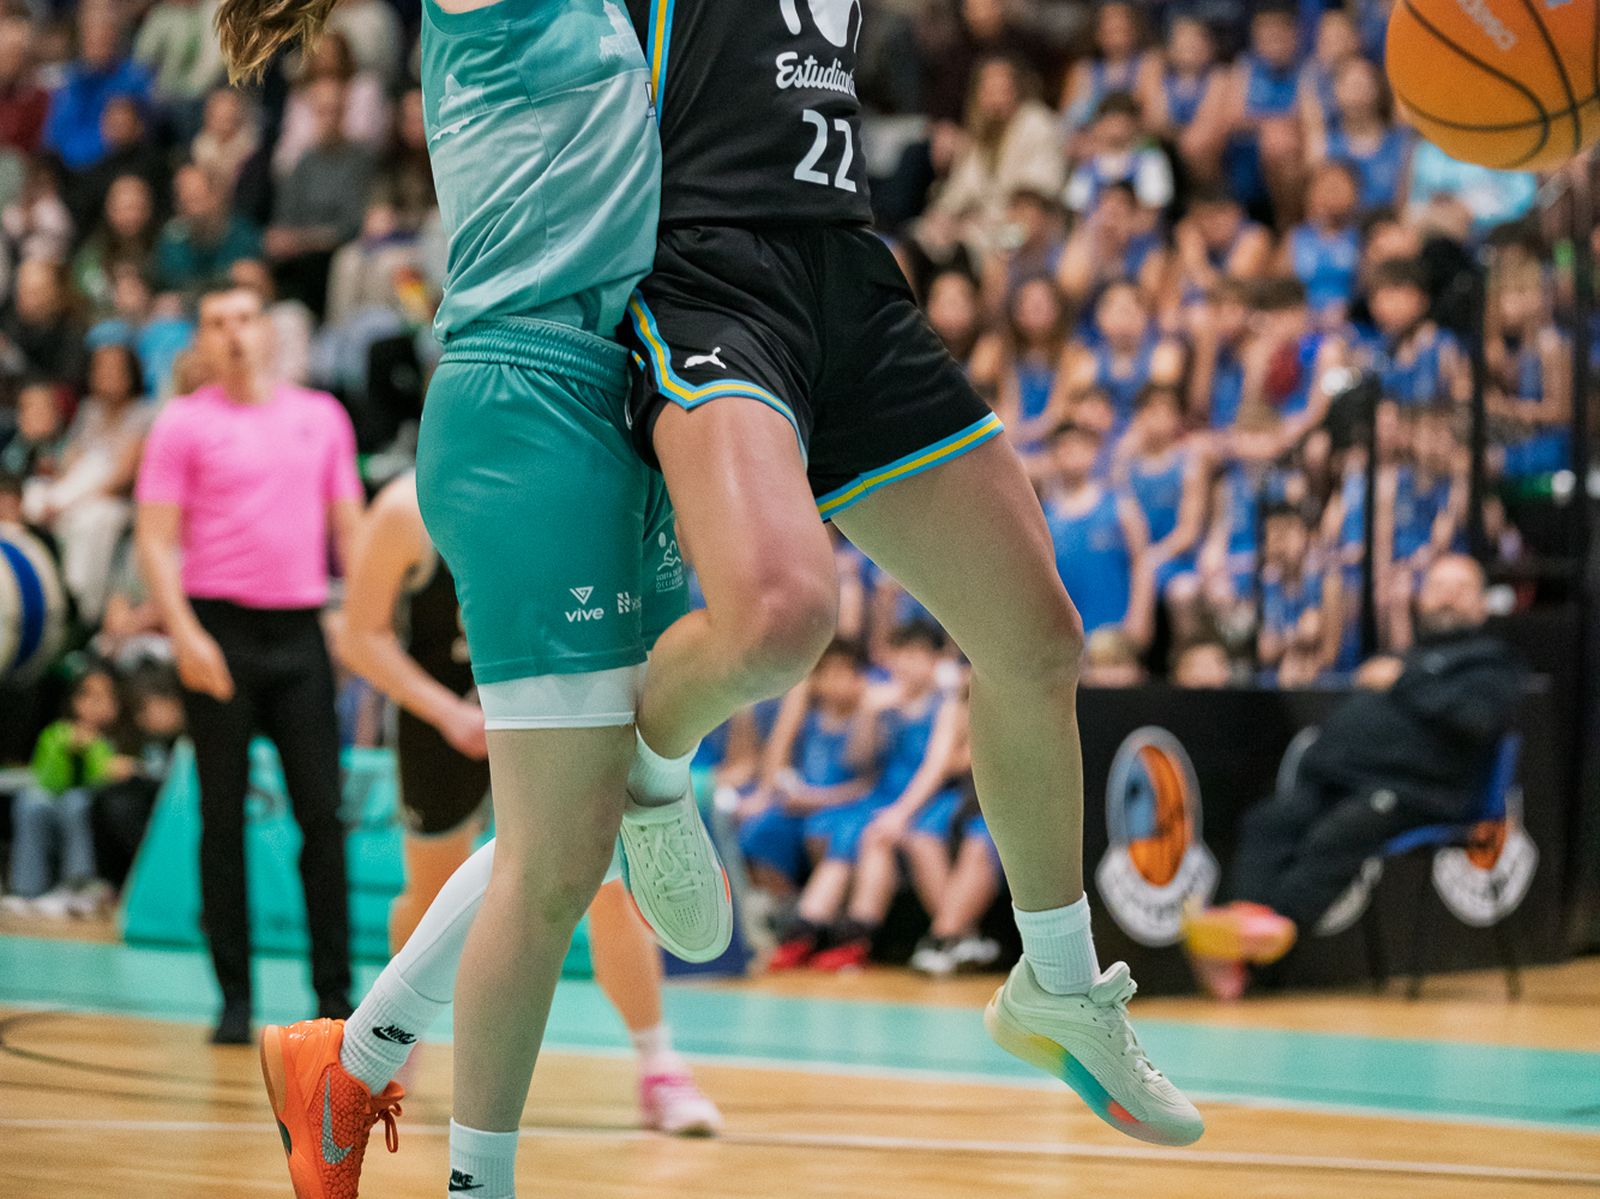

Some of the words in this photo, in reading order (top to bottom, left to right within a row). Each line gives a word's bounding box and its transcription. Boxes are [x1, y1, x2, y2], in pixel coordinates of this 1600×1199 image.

[793, 109, 857, 193] 22
[565, 607, 605, 623] vive
[383, 1024, 415, 1043] NIKE
[450, 1168, 474, 1188] NIKE
